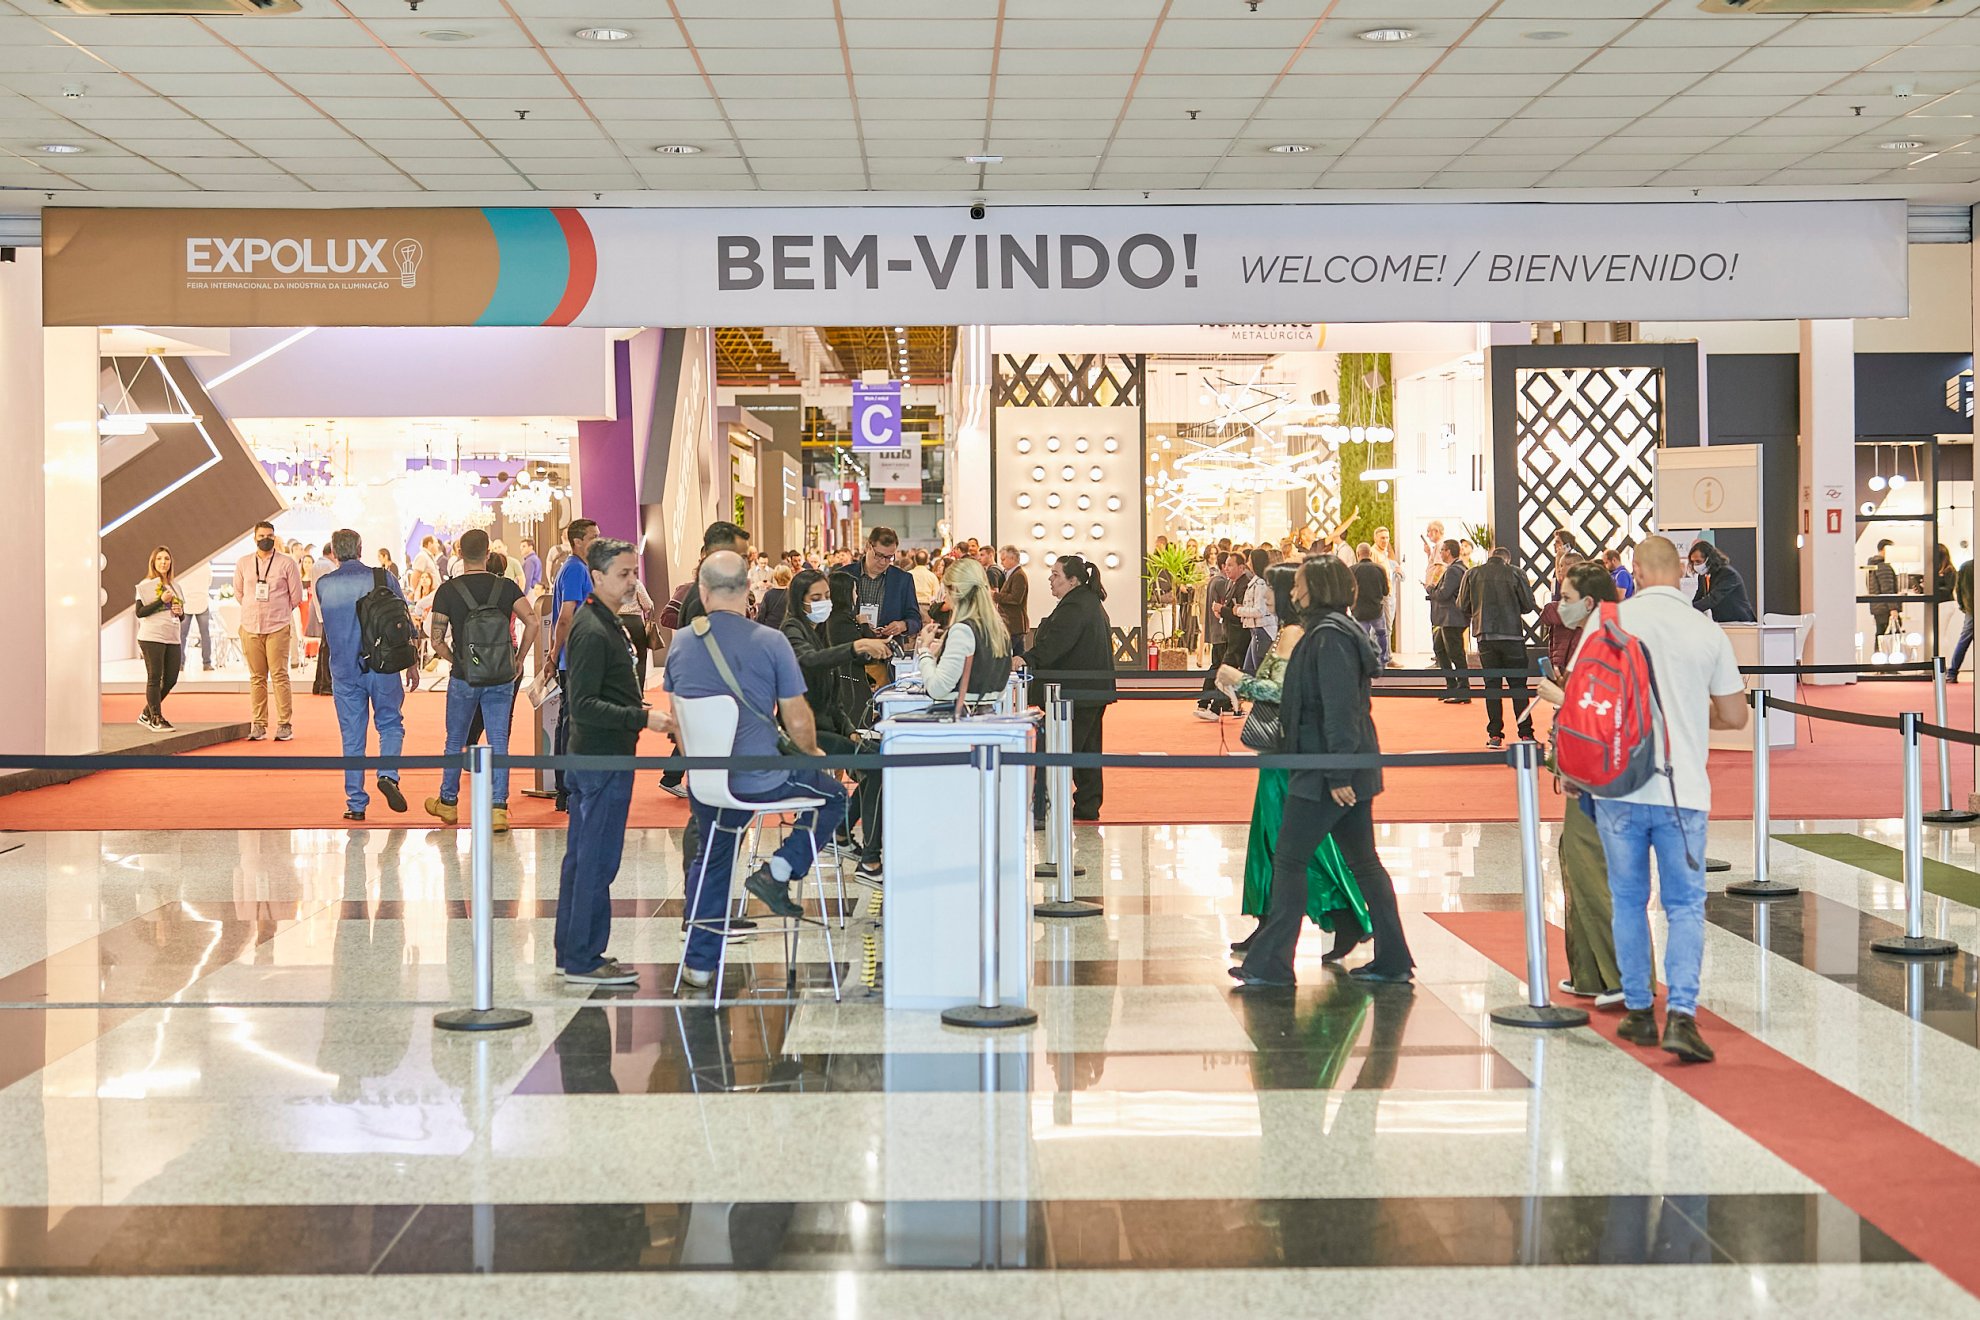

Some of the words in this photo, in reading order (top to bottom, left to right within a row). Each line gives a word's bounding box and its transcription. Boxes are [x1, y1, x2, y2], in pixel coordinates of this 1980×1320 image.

[186, 238, 389, 274] EXPOLUX
[717, 233, 1198, 291] BEM-VINDO!
[1241, 254, 1447, 284] WELCOME!
[1453, 250, 1481, 287] /
[1488, 253, 1739, 283] BIENVENIDO!
[210, 282, 272, 290] INTERNACIONAL
[286, 281, 327, 289] INDÚSTRIA
[328, 282, 340, 290] DA
[341, 281, 390, 290] ILUMINAÇÃO
[1231, 328, 1313, 340] METALÚRGICA
[861, 404, 893, 444] C
